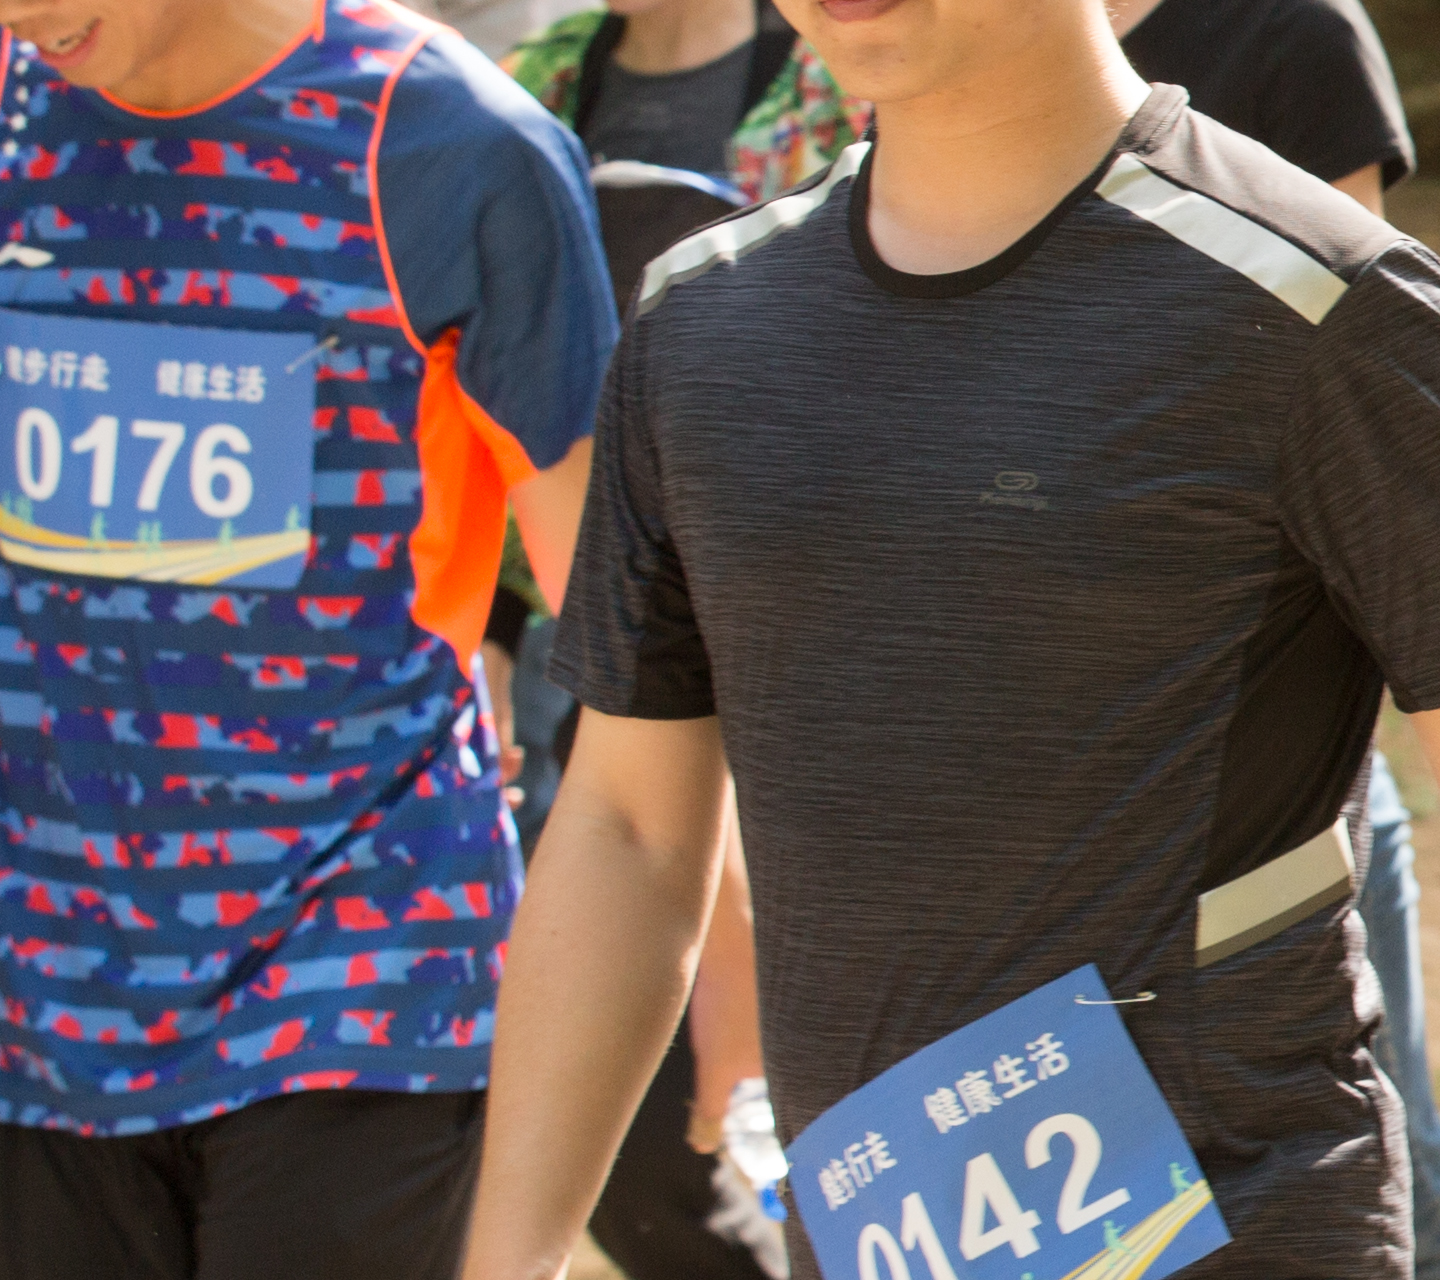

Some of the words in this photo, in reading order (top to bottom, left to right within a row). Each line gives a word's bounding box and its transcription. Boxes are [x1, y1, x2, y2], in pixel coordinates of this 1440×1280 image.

[15, 407, 254, 518] 0176
[922, 1032, 1070, 1134] 健康生活
